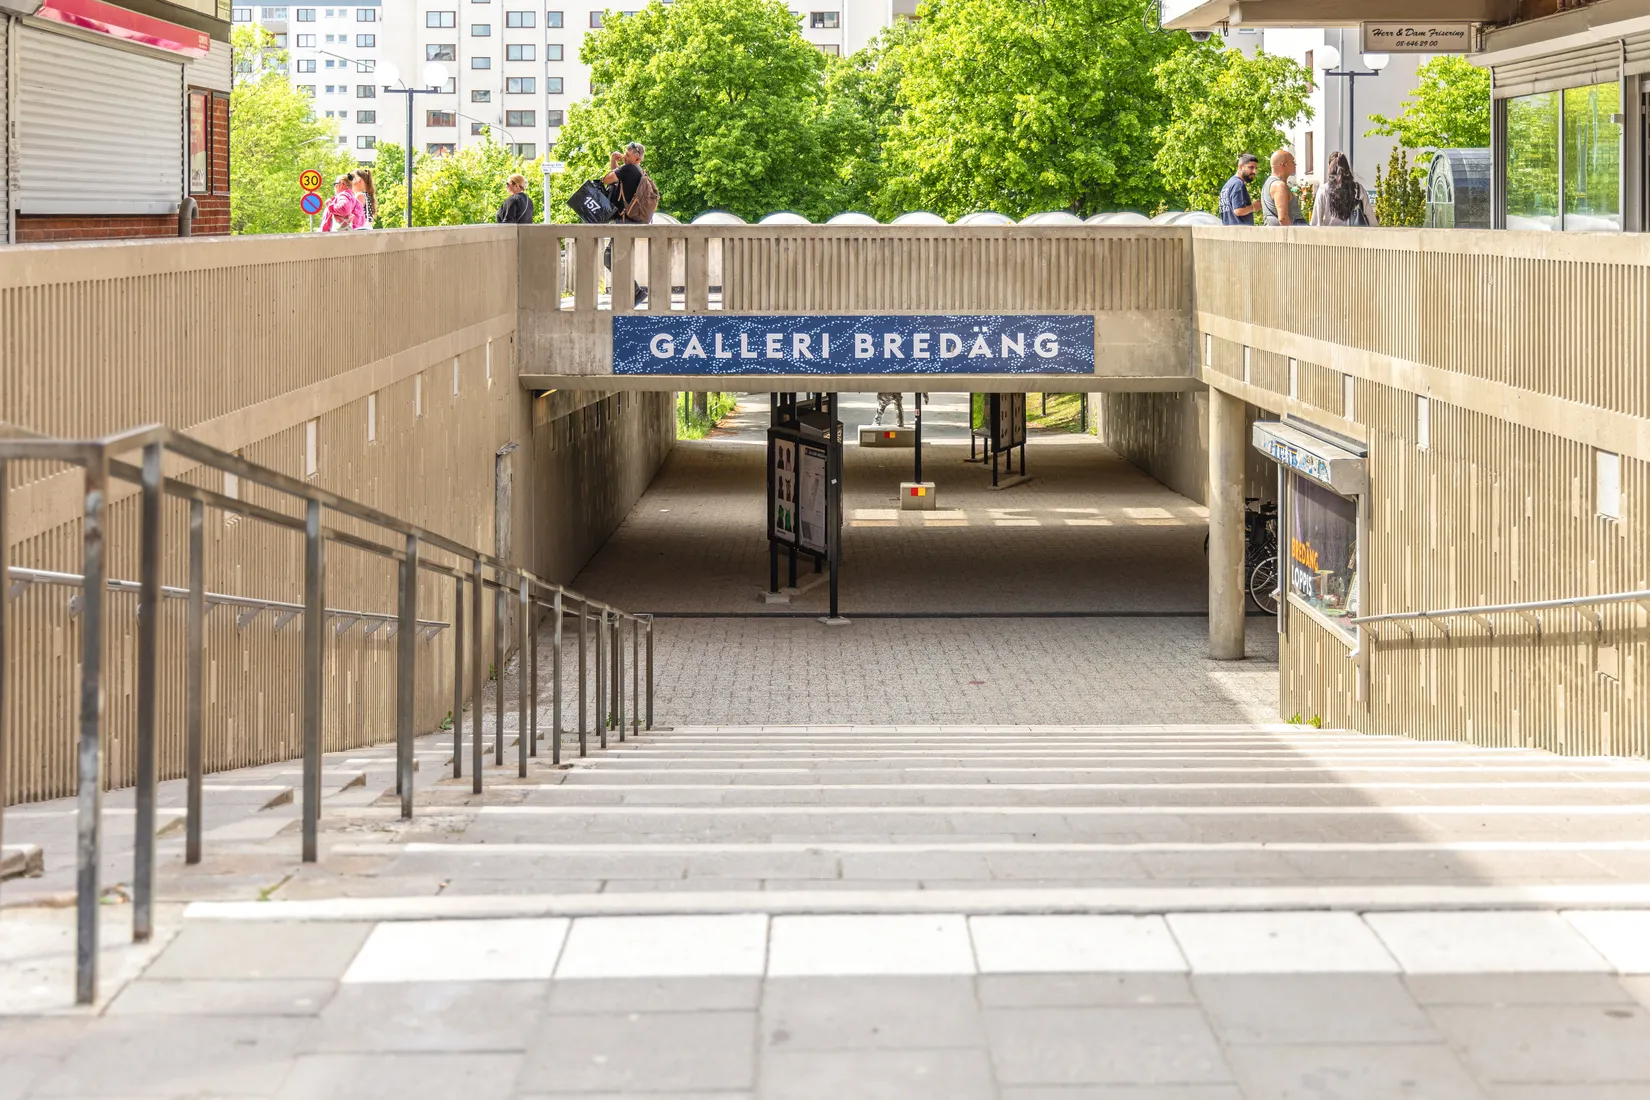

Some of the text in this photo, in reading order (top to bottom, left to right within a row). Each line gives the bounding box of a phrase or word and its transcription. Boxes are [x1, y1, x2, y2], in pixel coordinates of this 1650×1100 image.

[1372, 28, 1464, 38] Herr & Dam Frisering
[304, 175, 318, 186] 30
[650, 326, 1059, 359] GALLERI BREDÄNG
[1291, 537, 1319, 573] BREDÄNG
[1291, 564, 1312, 597] LOPPIS
